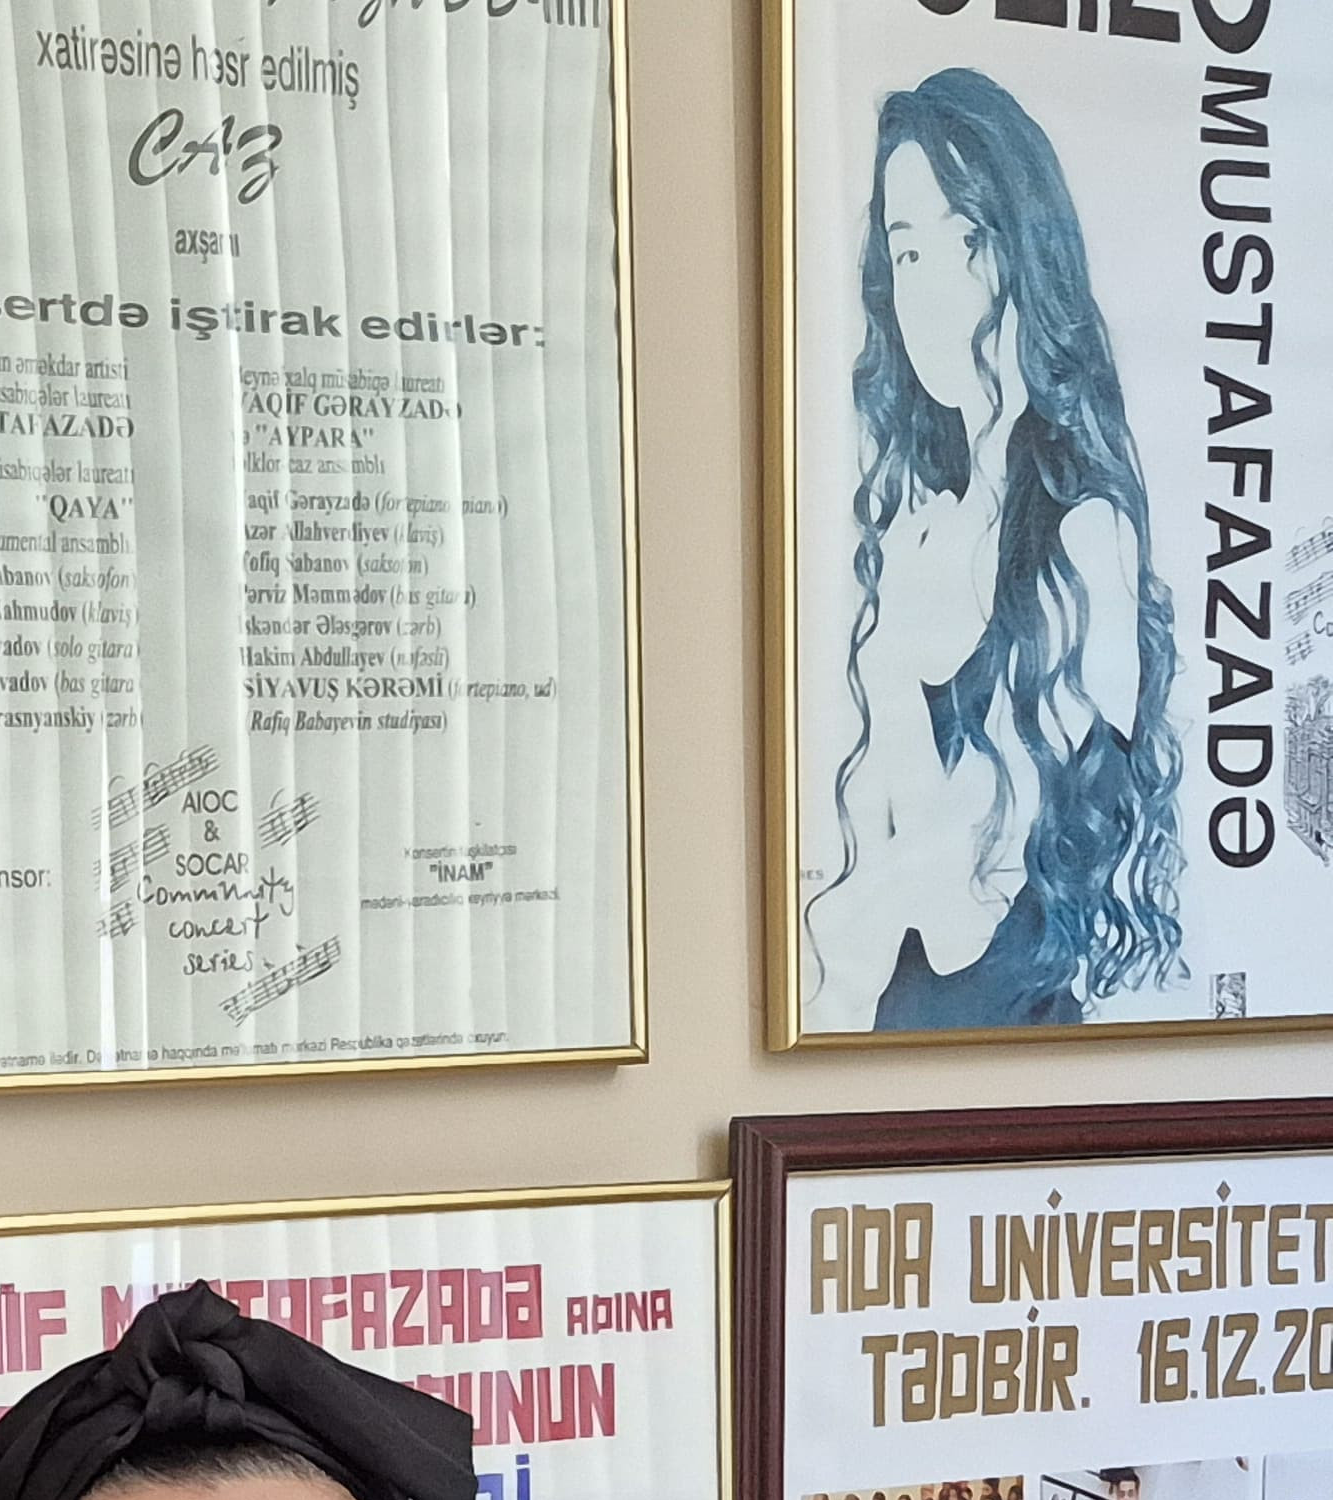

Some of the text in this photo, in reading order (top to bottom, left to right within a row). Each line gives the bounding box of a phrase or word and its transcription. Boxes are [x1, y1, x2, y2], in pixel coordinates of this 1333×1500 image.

[37, 26, 181, 83] xatirəsinə
[261, 46, 359, 110] edilmiş
[128, 108, 284, 205] CAZ
[170, 298, 342, 340] iştirak
[1200, 66, 1274, 867] MUSTAFAZADƏ
[182, 789, 239, 814] AIOC
[204, 819, 220, 843] &
[176, 853, 250, 877] SOCAR
[810, 1203, 933, 1314] ADA
[567, 1288, 673, 1336] ADINA
